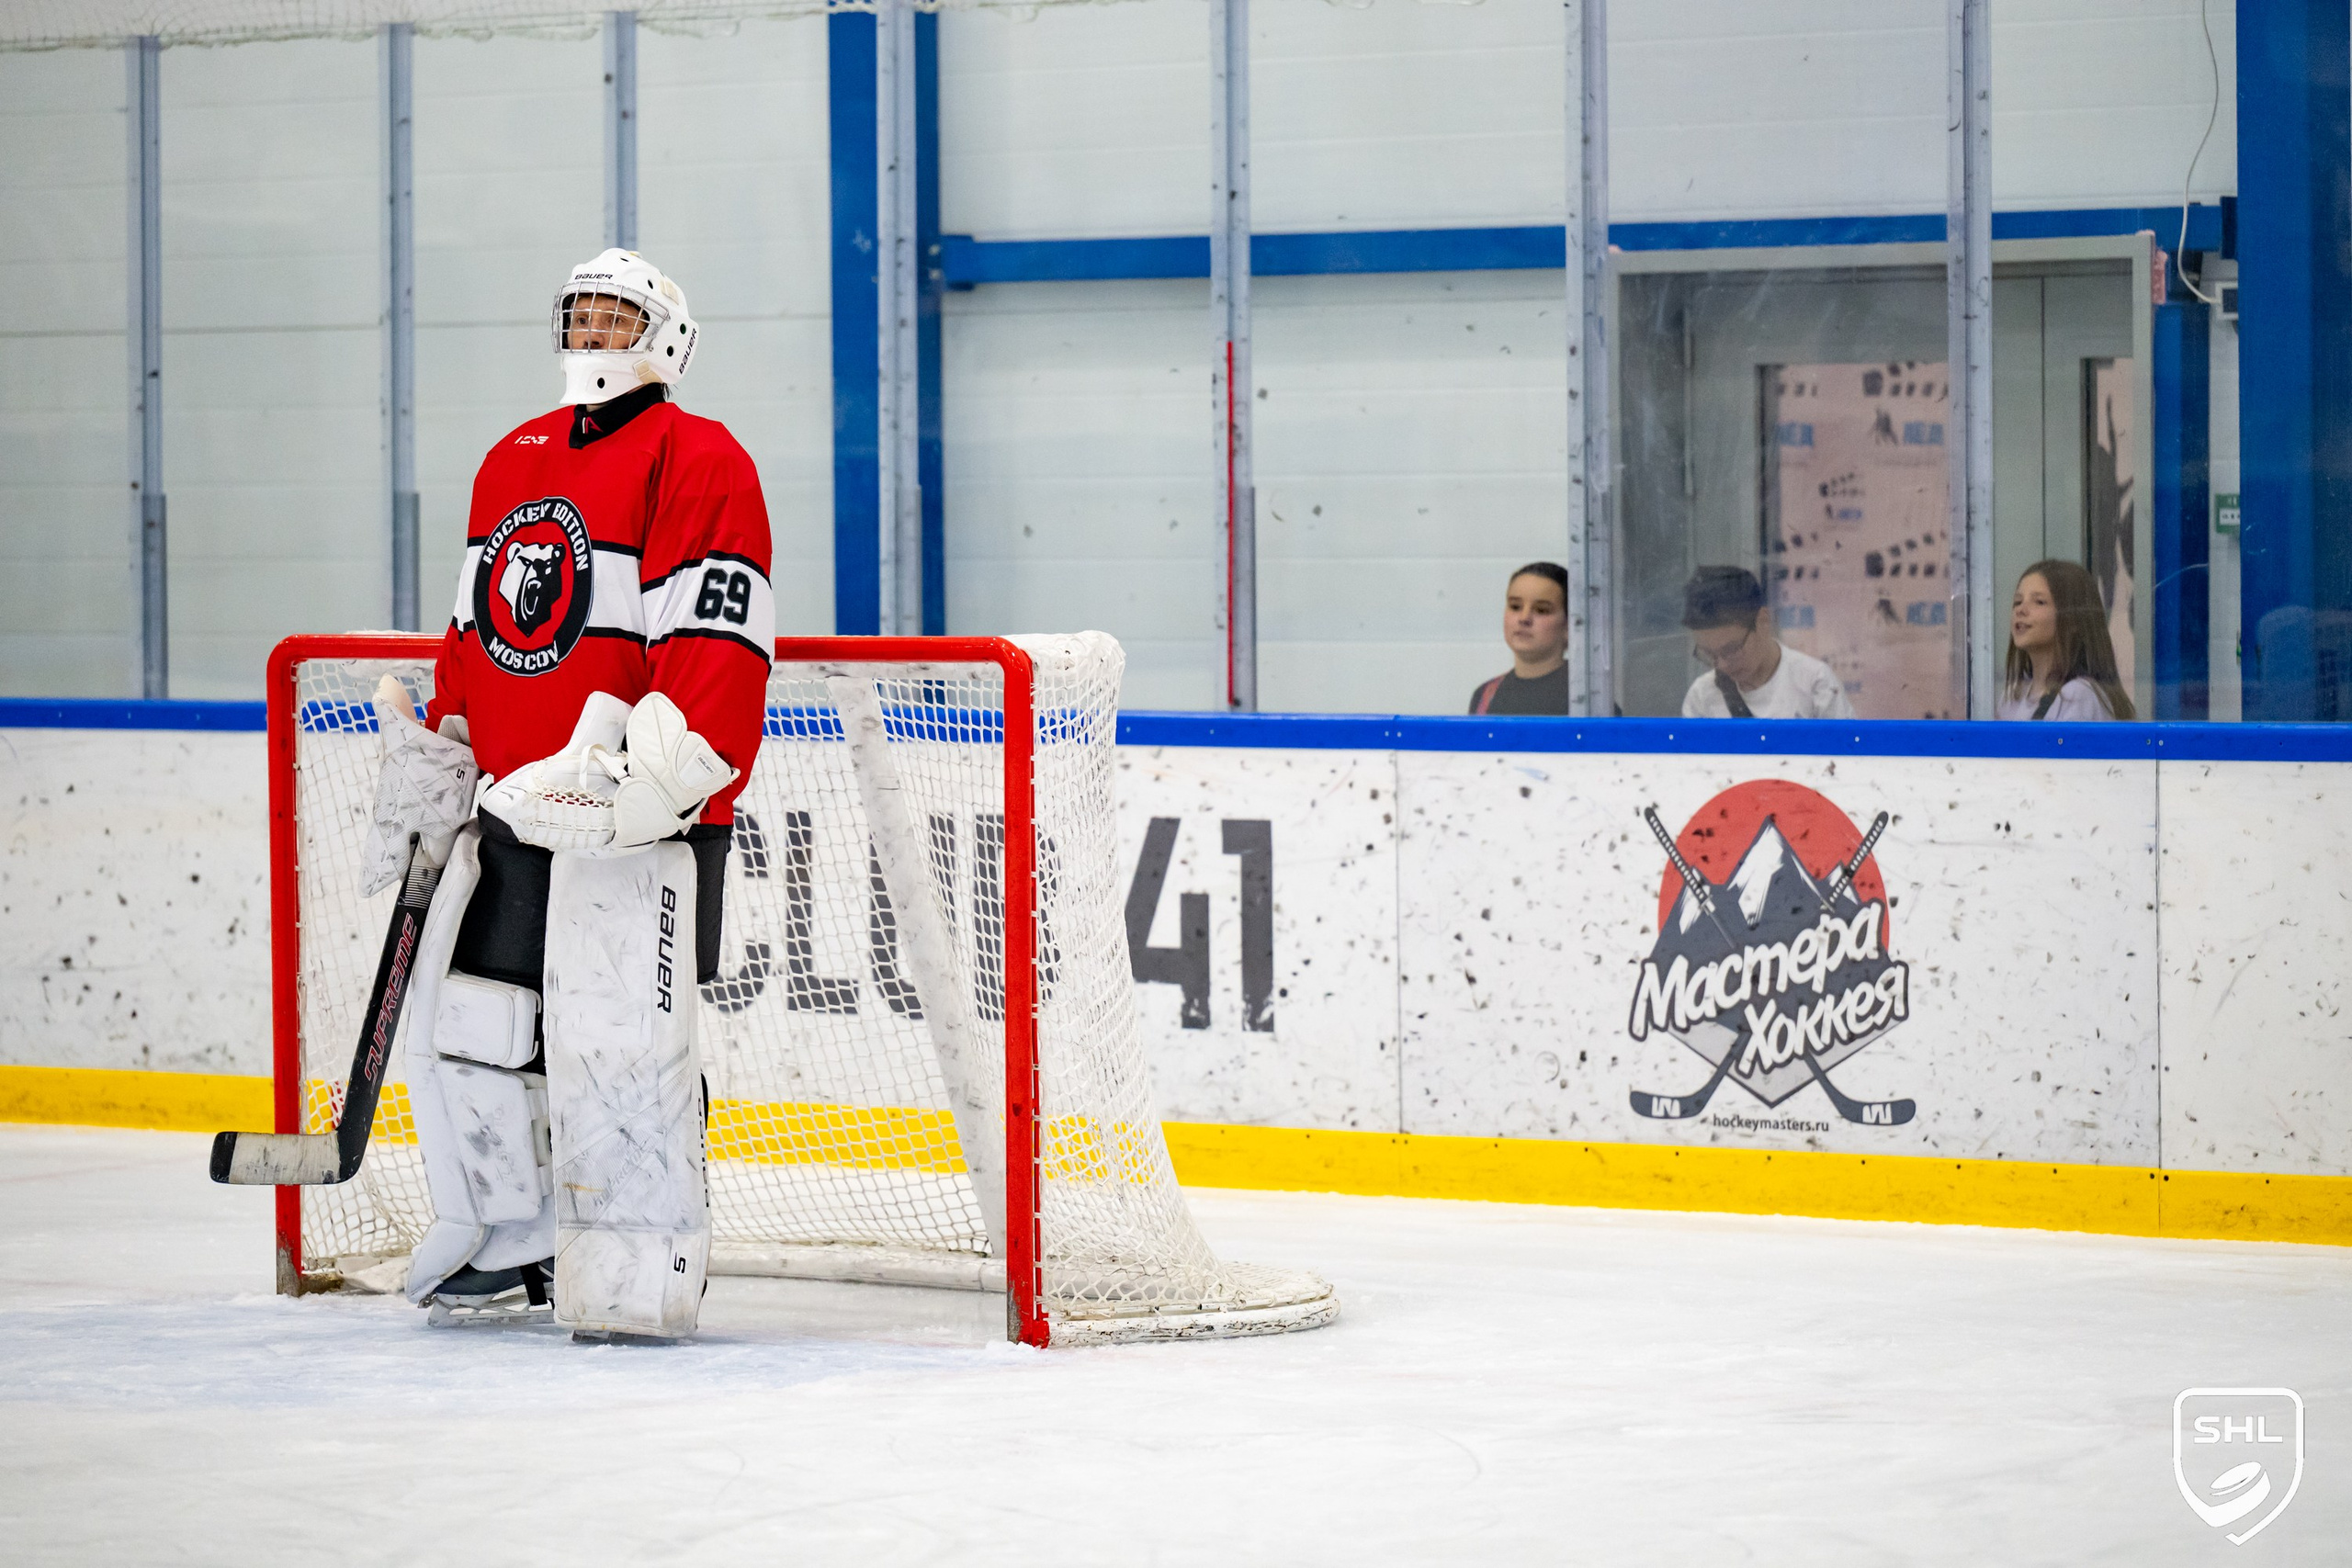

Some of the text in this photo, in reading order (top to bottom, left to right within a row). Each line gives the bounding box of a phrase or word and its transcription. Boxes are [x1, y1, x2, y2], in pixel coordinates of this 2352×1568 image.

[678, 328, 696, 375] BAUER
[482, 502, 589, 571] HOCKEY EDITION
[695, 568, 752, 626] 69
[657, 885, 676, 1013] BAUER
[1124, 817, 1274, 1032] 41
[1632, 902, 1883, 1040] Мастера
[364, 912, 417, 1090] SUPREME
[1736, 963, 1906, 1075] Хоккея
[1713, 1114, 1830, 1133] hockeymasters.ru
